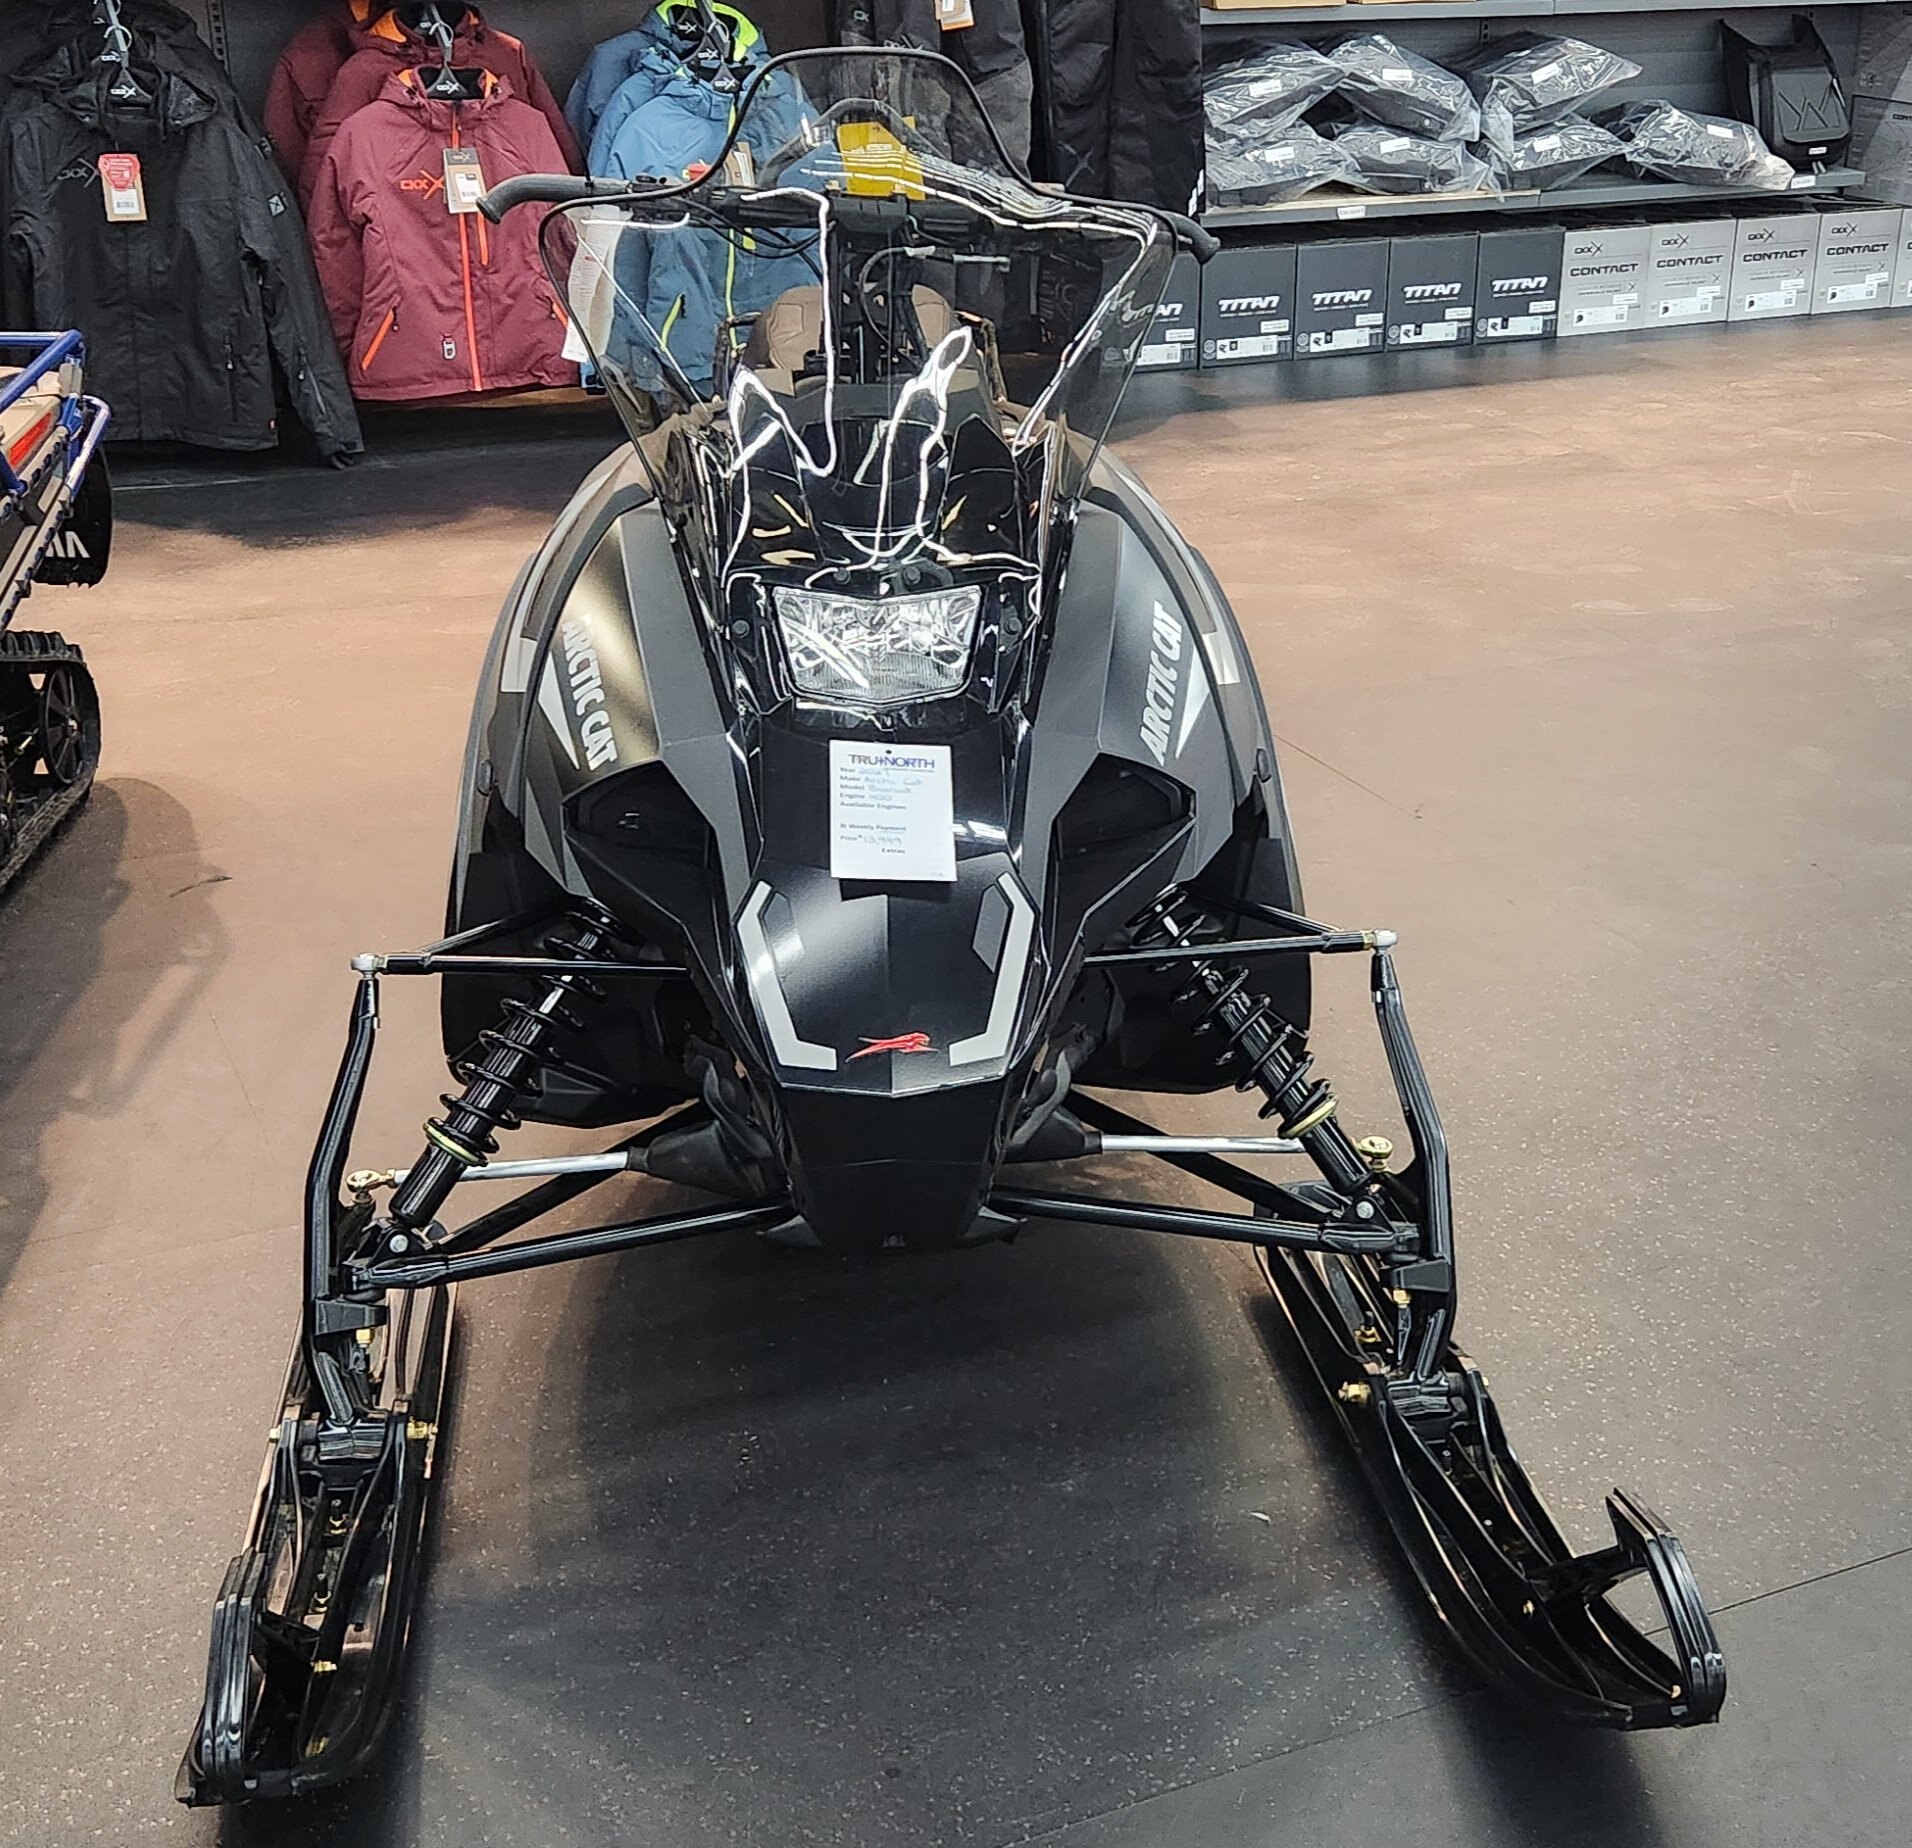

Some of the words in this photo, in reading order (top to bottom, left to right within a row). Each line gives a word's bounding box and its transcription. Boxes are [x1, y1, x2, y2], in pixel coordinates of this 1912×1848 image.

[1743, 249, 1809, 262] CONTACT
[1826, 243, 1890, 256] CONTACT
[1656, 255, 1724, 268] CONTACT
[1570, 263, 1639, 277] CONTACT
[1403, 283, 1462, 298] TITAN
[1491, 276, 1549, 292] TITAN
[1218, 295, 1280, 312] TITAN
[1311, 289, 1373, 305] TITAN
[1151, 599, 1183, 662] CAT
[1139, 649, 1178, 768] ARCTIC
[580, 709, 619, 772] CAT
